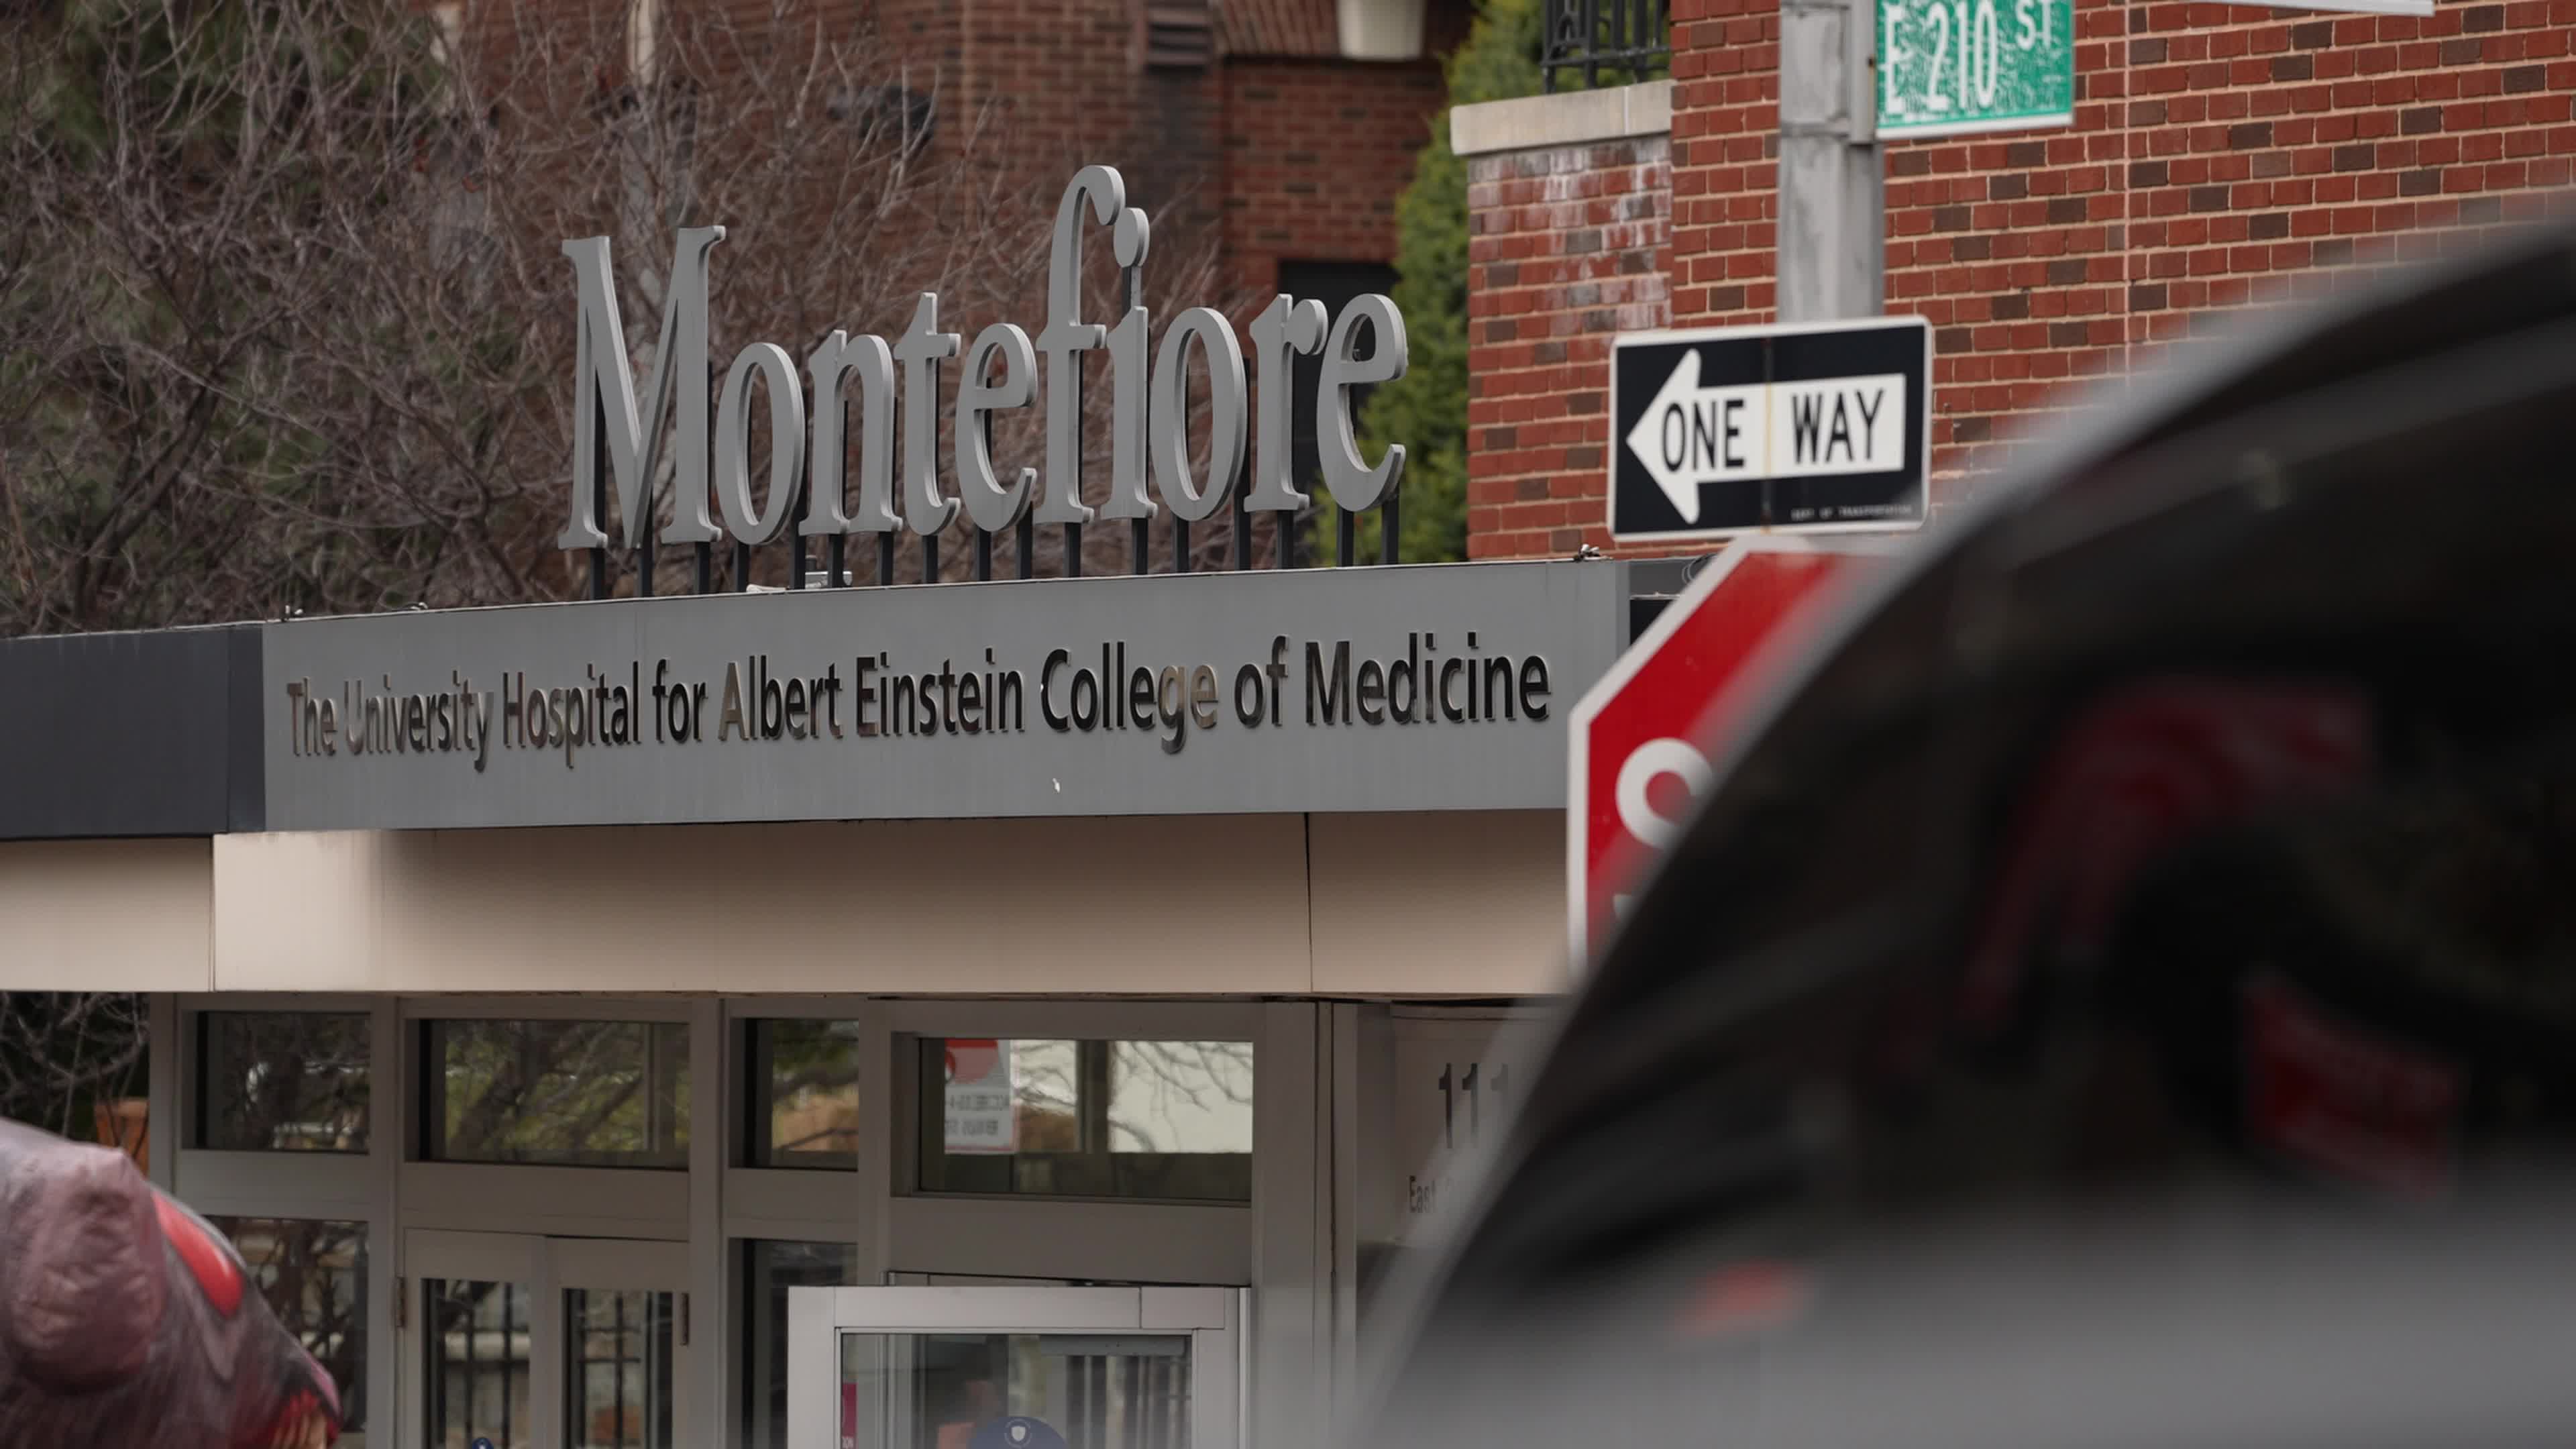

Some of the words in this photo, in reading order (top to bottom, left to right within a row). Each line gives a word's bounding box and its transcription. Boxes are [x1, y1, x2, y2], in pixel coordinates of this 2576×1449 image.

[1884, 5, 1907, 115] E
[1925, 0, 1997, 112] 210
[2015, 0, 2057, 51] ST
[557, 164, 1409, 550] Montefiore
[1662, 398, 1746, 473] ONE
[1790, 388, 1883, 465] WAY
[287, 677, 337, 757] The
[344, 669, 494, 773] University
[502, 659, 641, 769] Hospital
[651, 658, 706, 744] for
[718, 655, 844, 741] Albert
[855, 647, 1024, 737] Einstein
[1040, 641, 1220, 755] College
[1233, 635, 1289, 730] of
[1304, 631, 1552, 727] Medicine
